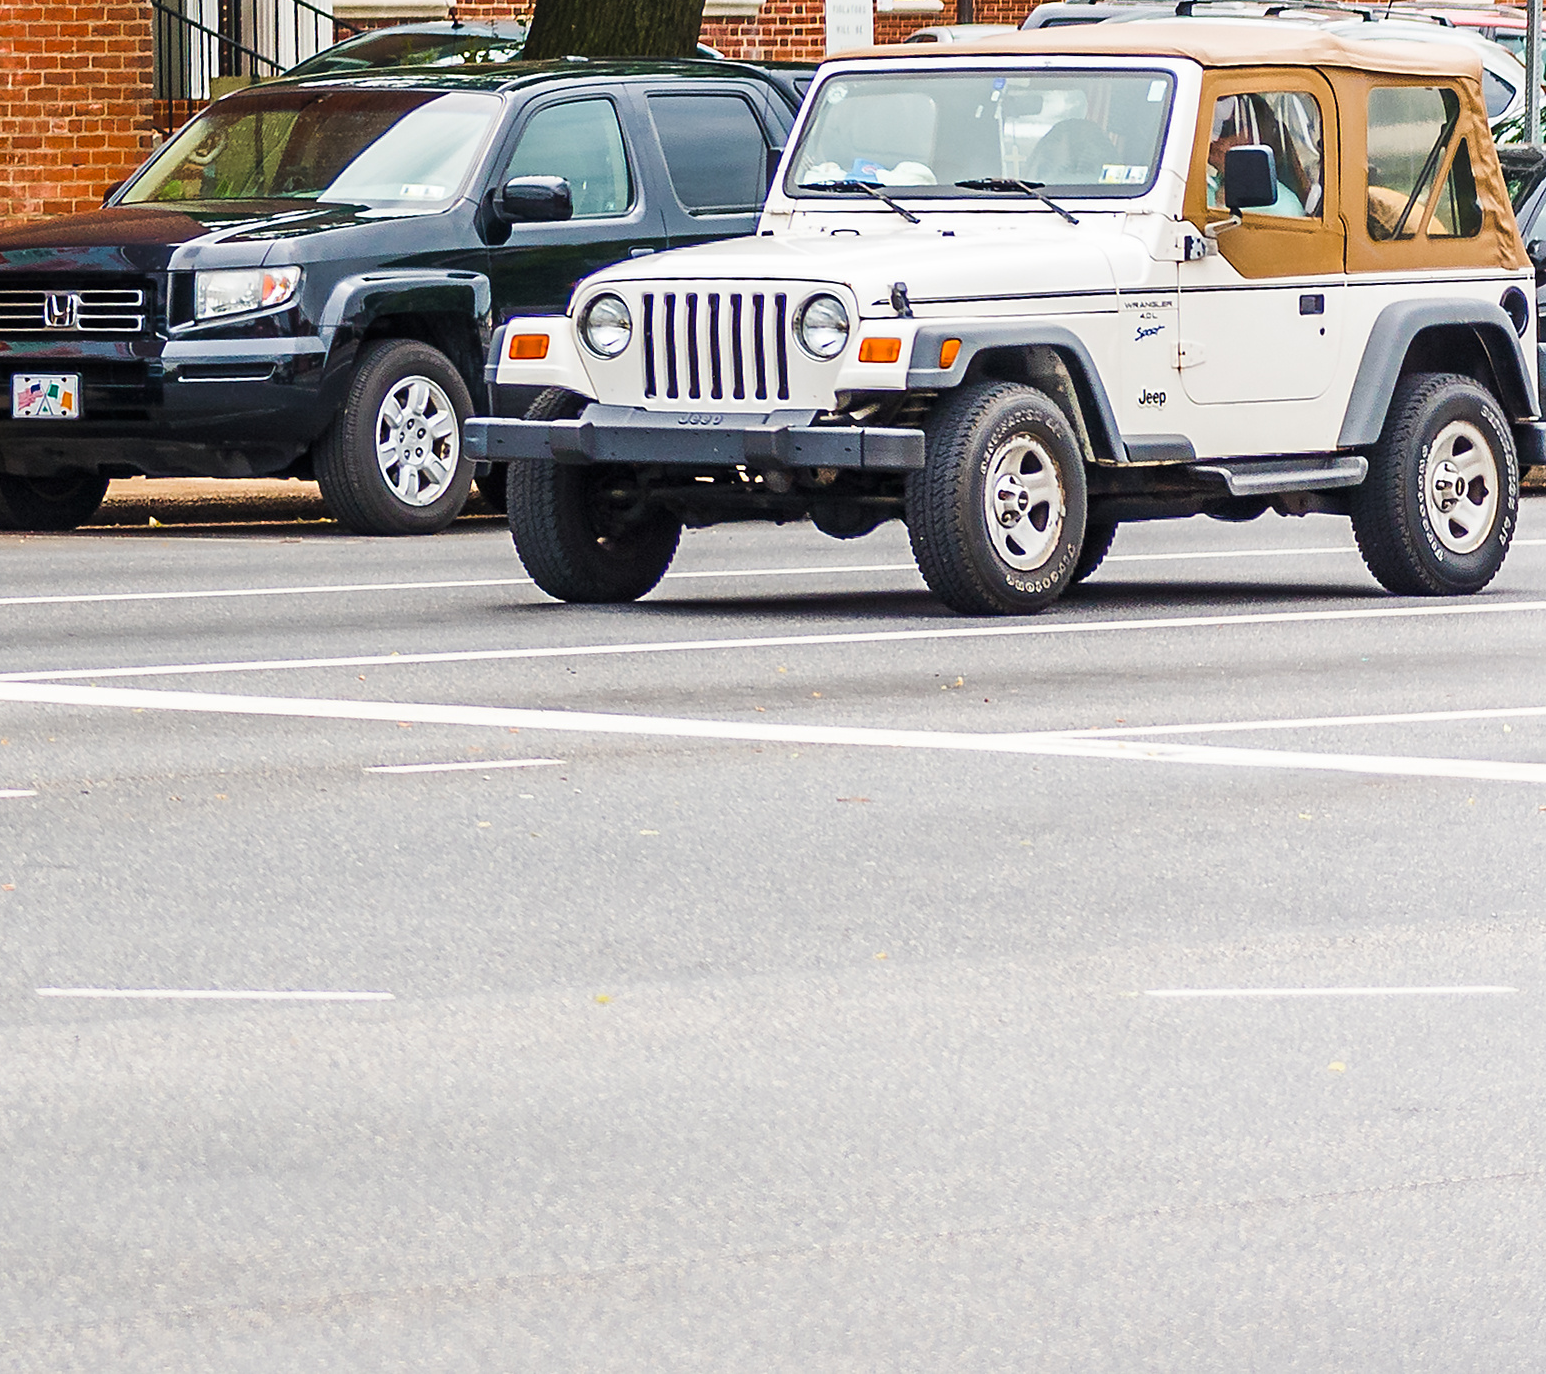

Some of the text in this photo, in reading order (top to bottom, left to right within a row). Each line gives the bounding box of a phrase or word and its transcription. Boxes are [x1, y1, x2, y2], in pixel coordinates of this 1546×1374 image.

[1124, 301, 1173, 309] WRANGLER
[1138, 389, 1167, 406] Jeep
[678, 413, 723, 425] Jeep
